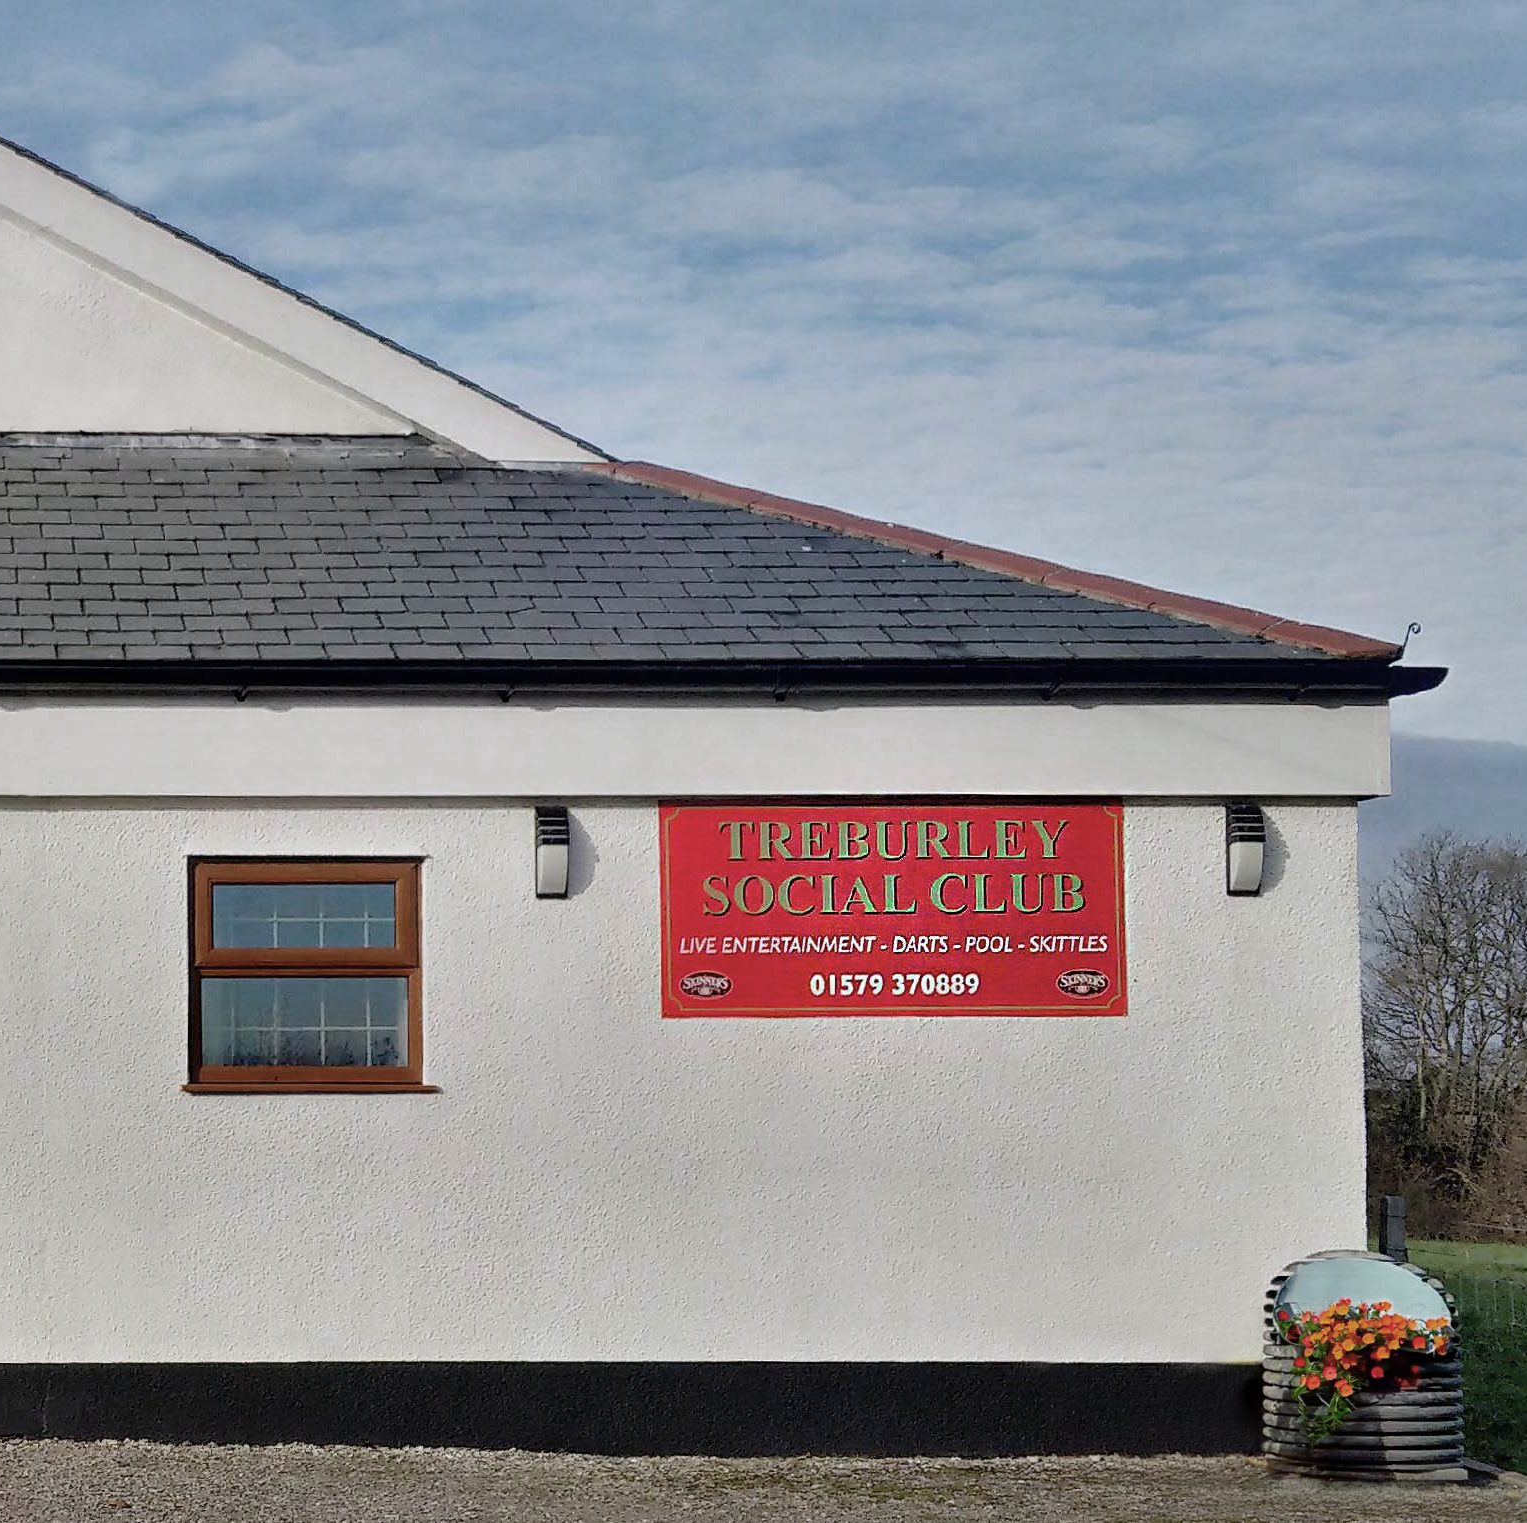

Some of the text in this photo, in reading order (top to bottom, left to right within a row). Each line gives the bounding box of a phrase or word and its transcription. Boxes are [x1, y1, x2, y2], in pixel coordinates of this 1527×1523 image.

[718, 820, 1069, 862] TREBURLEY
[702, 872, 1086, 915] SOCIAL CLUB
[680, 936, 717, 954] LIVE
[722, 935, 877, 954] ENTERTAINMENT
[892, 935, 949, 953] DARTS
[965, 935, 1014, 953] POOL
[1029, 935, 1108, 953] SKITTLES
[810, 973, 980, 996] 01579 370889
